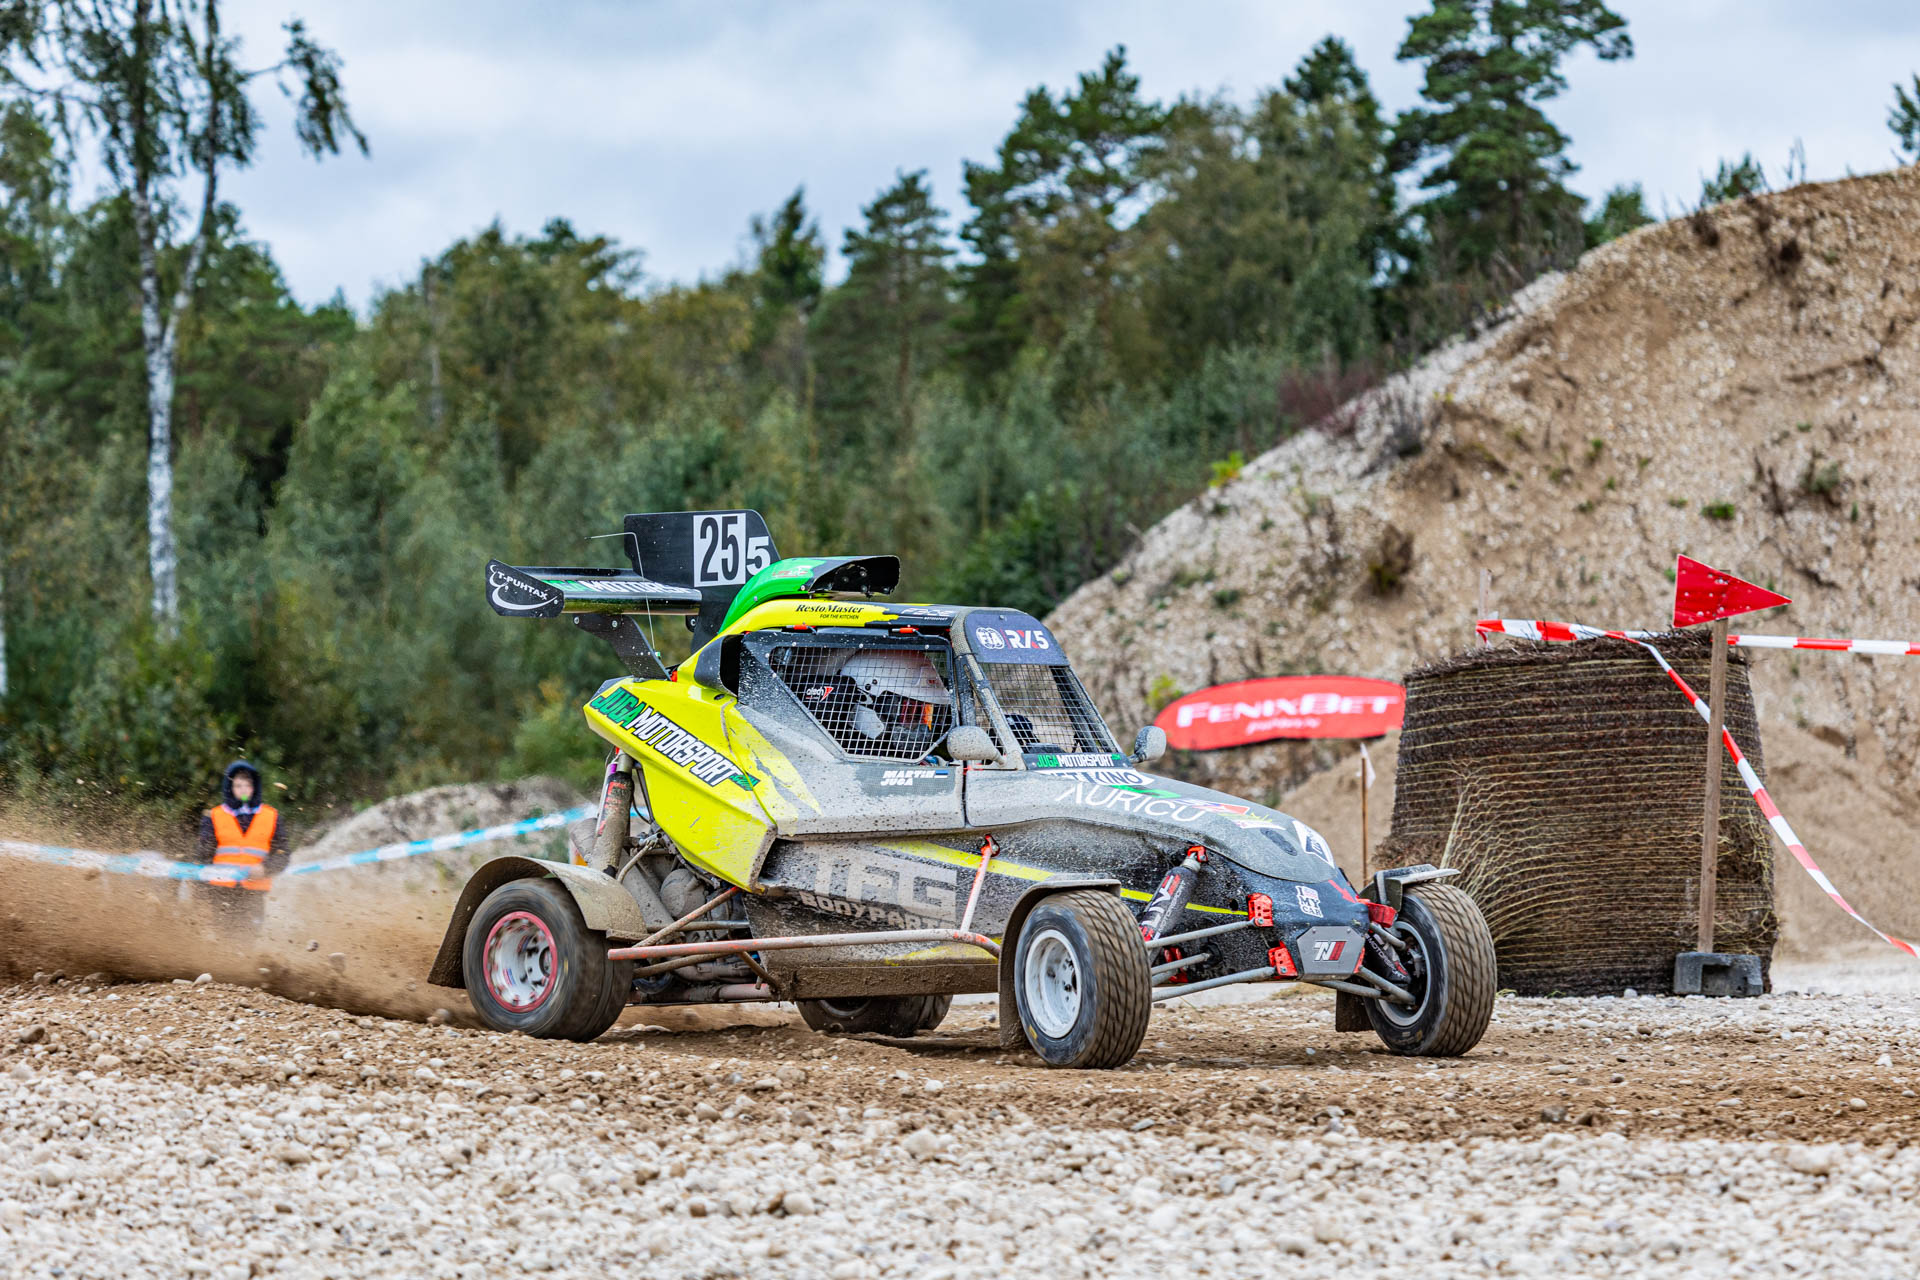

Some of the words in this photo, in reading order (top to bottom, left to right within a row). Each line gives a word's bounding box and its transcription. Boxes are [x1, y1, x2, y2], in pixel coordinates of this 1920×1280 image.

[700, 515, 740, 583] 25
[746, 536, 771, 576] 5
[497, 571, 549, 601] T-PUHTAX
[795, 604, 865, 614] RestoMaster
[880, 778, 914, 786] JUGA
